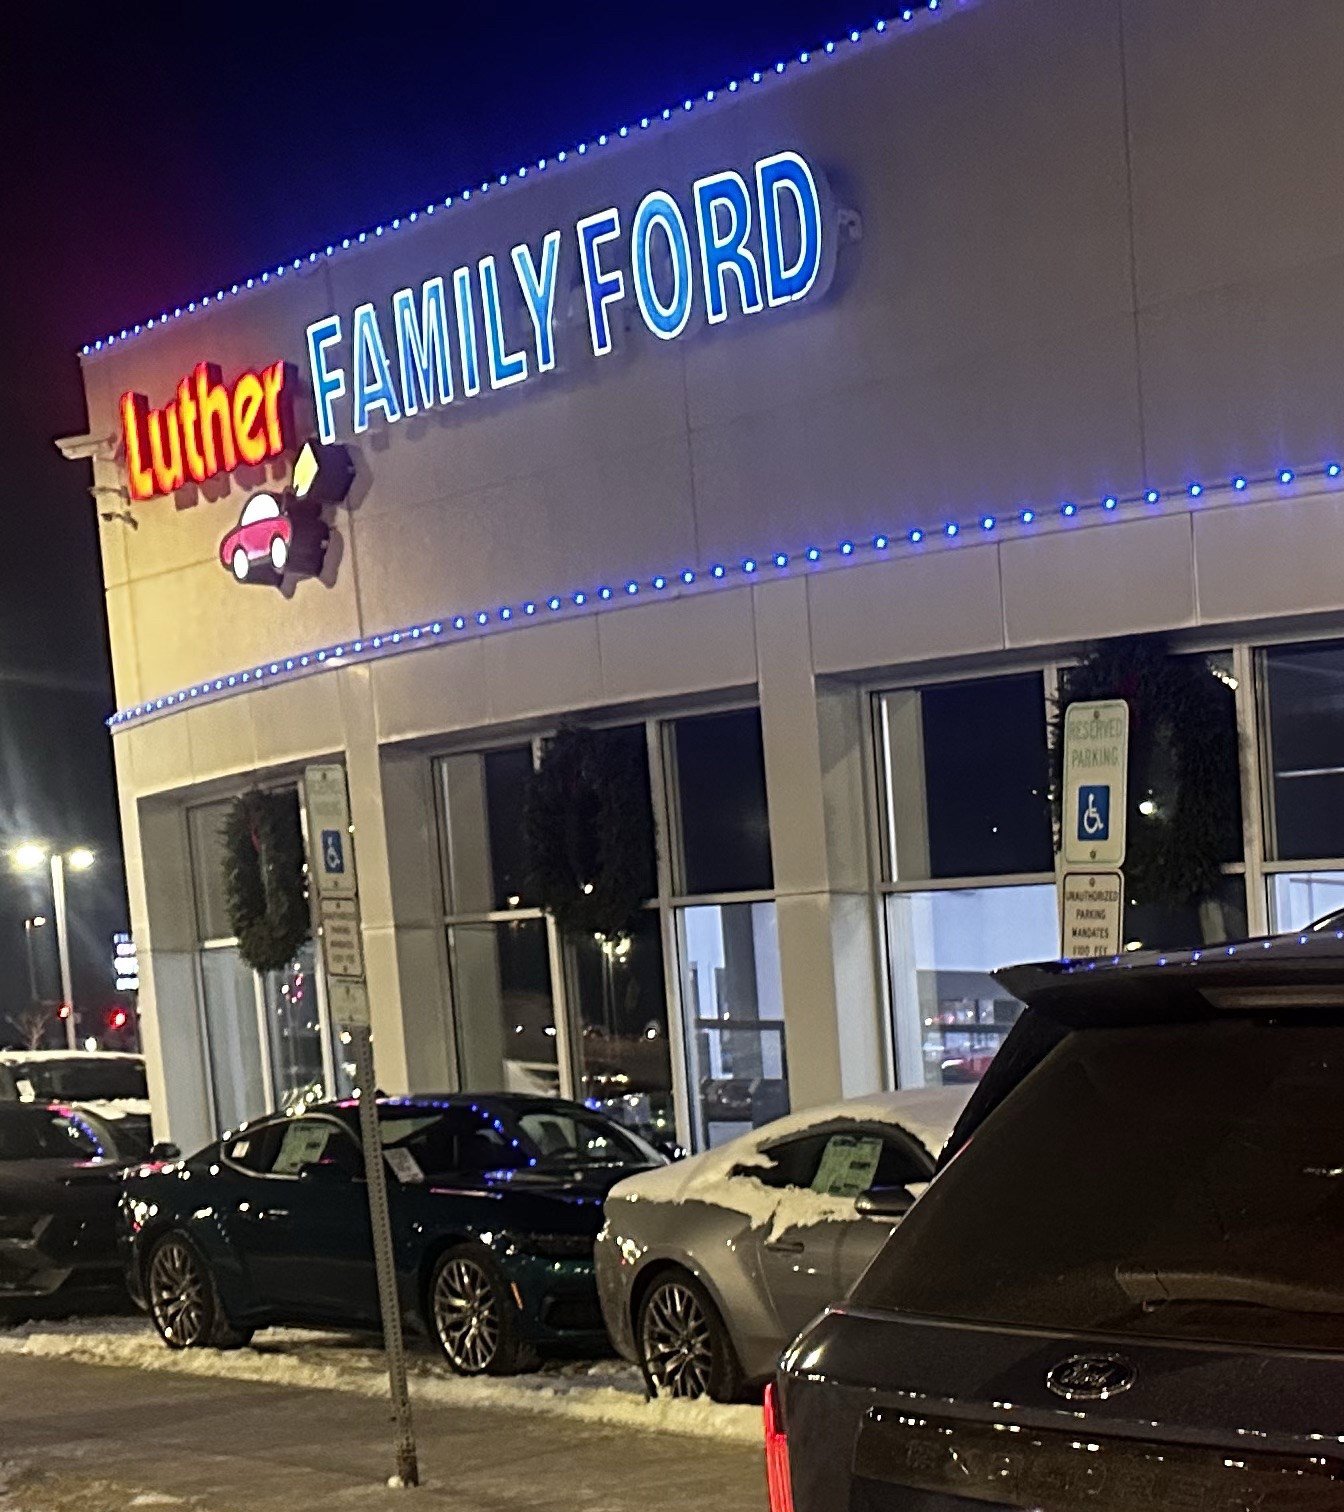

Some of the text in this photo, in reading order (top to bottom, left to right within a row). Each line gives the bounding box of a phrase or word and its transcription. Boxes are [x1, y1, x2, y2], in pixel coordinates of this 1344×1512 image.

[306, 150, 822, 446] FAMILY FORD
[120, 360, 287, 502] Luther
[1068, 718, 1122, 740] RESERVED
[1071, 746, 1119, 768] PARKING
[1066, 890, 1119, 901] UNAUTHORIZED
[1076, 908, 1106, 920] PARKING
